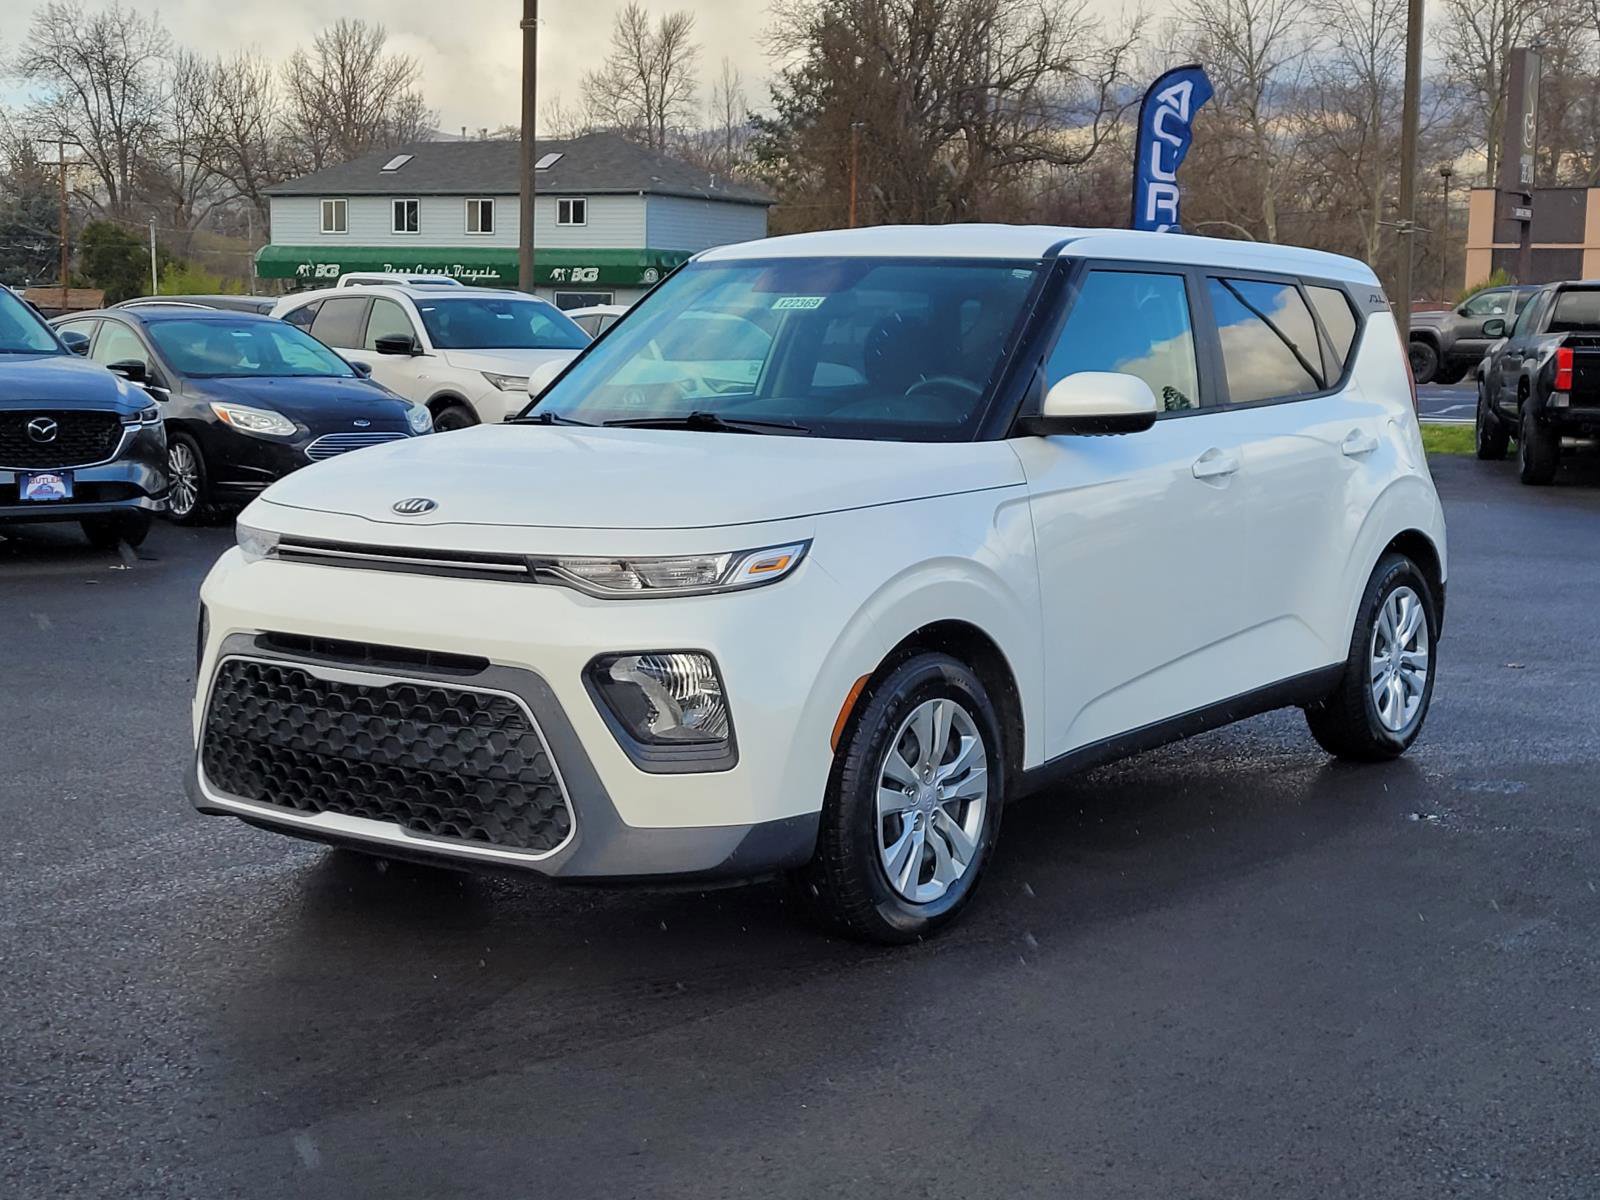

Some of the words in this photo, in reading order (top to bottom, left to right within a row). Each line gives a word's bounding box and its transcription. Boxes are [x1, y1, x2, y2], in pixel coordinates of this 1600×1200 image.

[1146, 79, 1194, 233] ACUR
[453, 264, 501, 282] Bicycle
[394, 498, 431, 513] KIA
